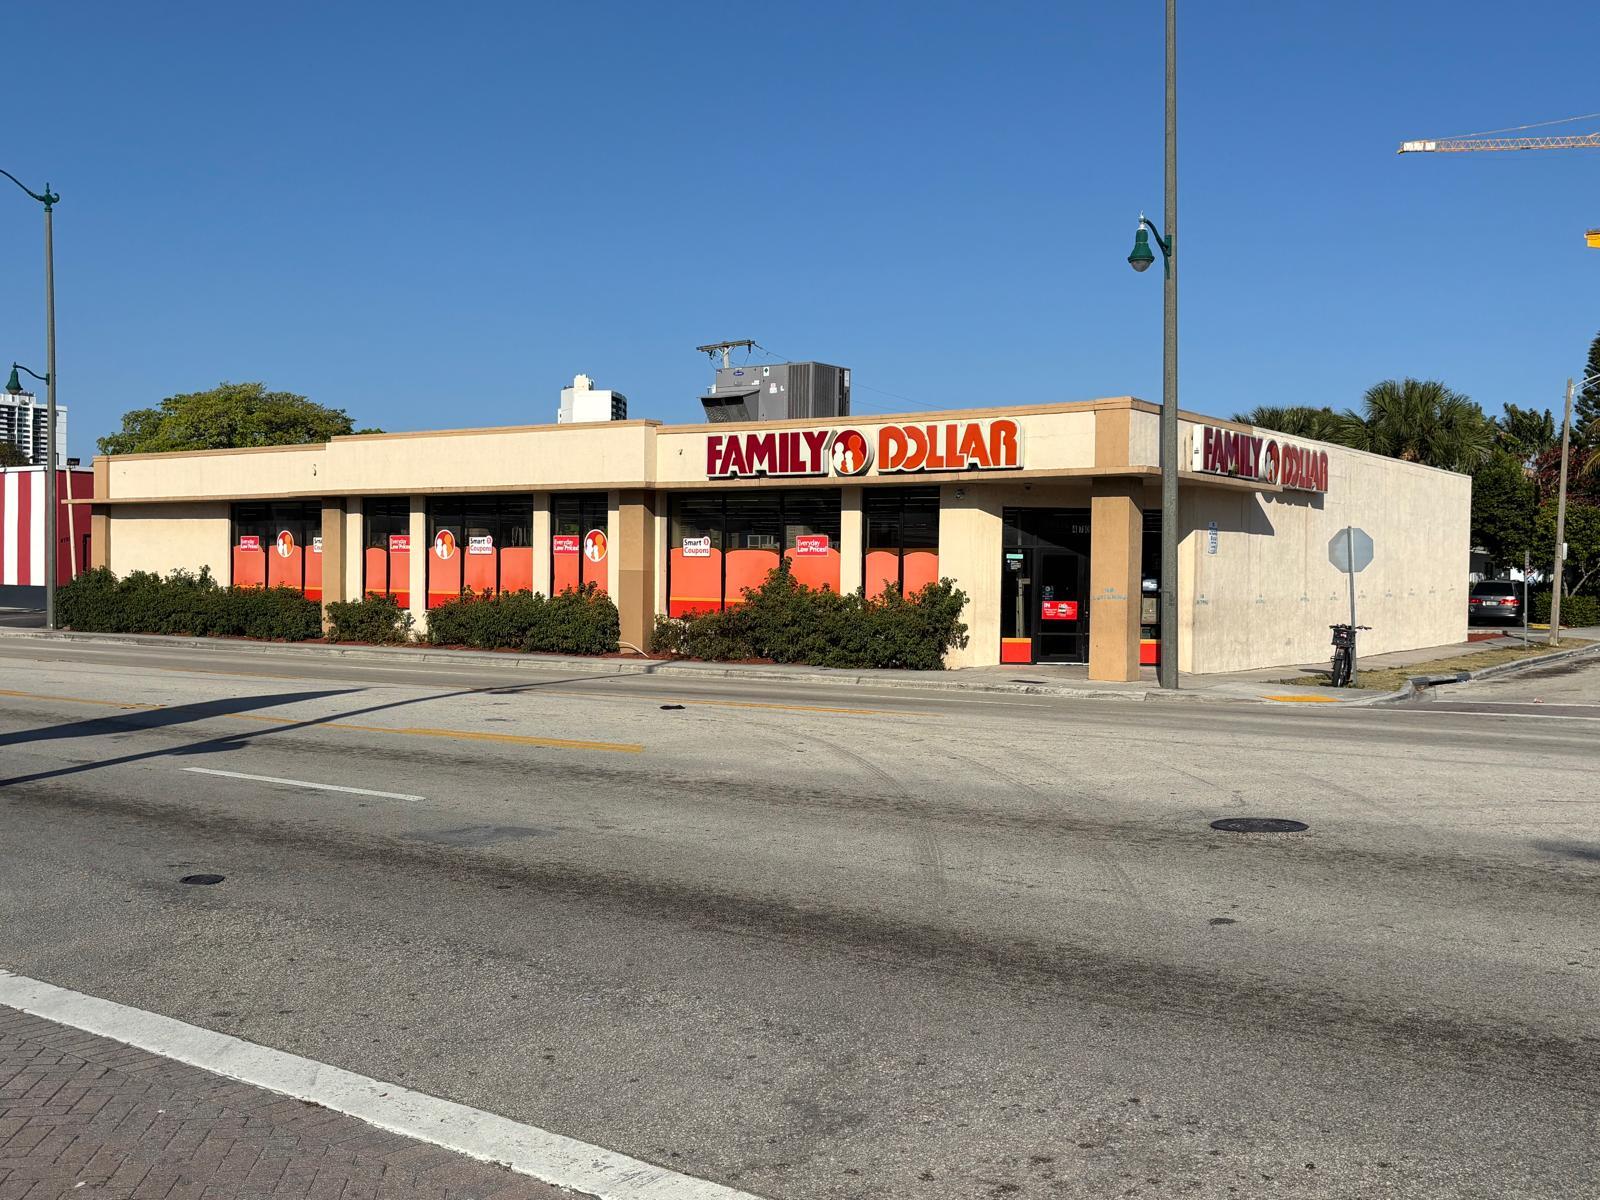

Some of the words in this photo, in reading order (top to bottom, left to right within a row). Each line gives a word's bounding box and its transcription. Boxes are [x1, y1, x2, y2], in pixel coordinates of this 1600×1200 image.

[707, 431, 829, 476] FAMILY
[879, 420, 1018, 470] DOLLAR
[1203, 427, 1264, 479] FAMILY
[1281, 443, 1329, 491] DOLLAR
[798, 539, 820, 548] Everyday
[470, 545, 492, 553] Coupons
[684, 547, 709, 555] Coupons
